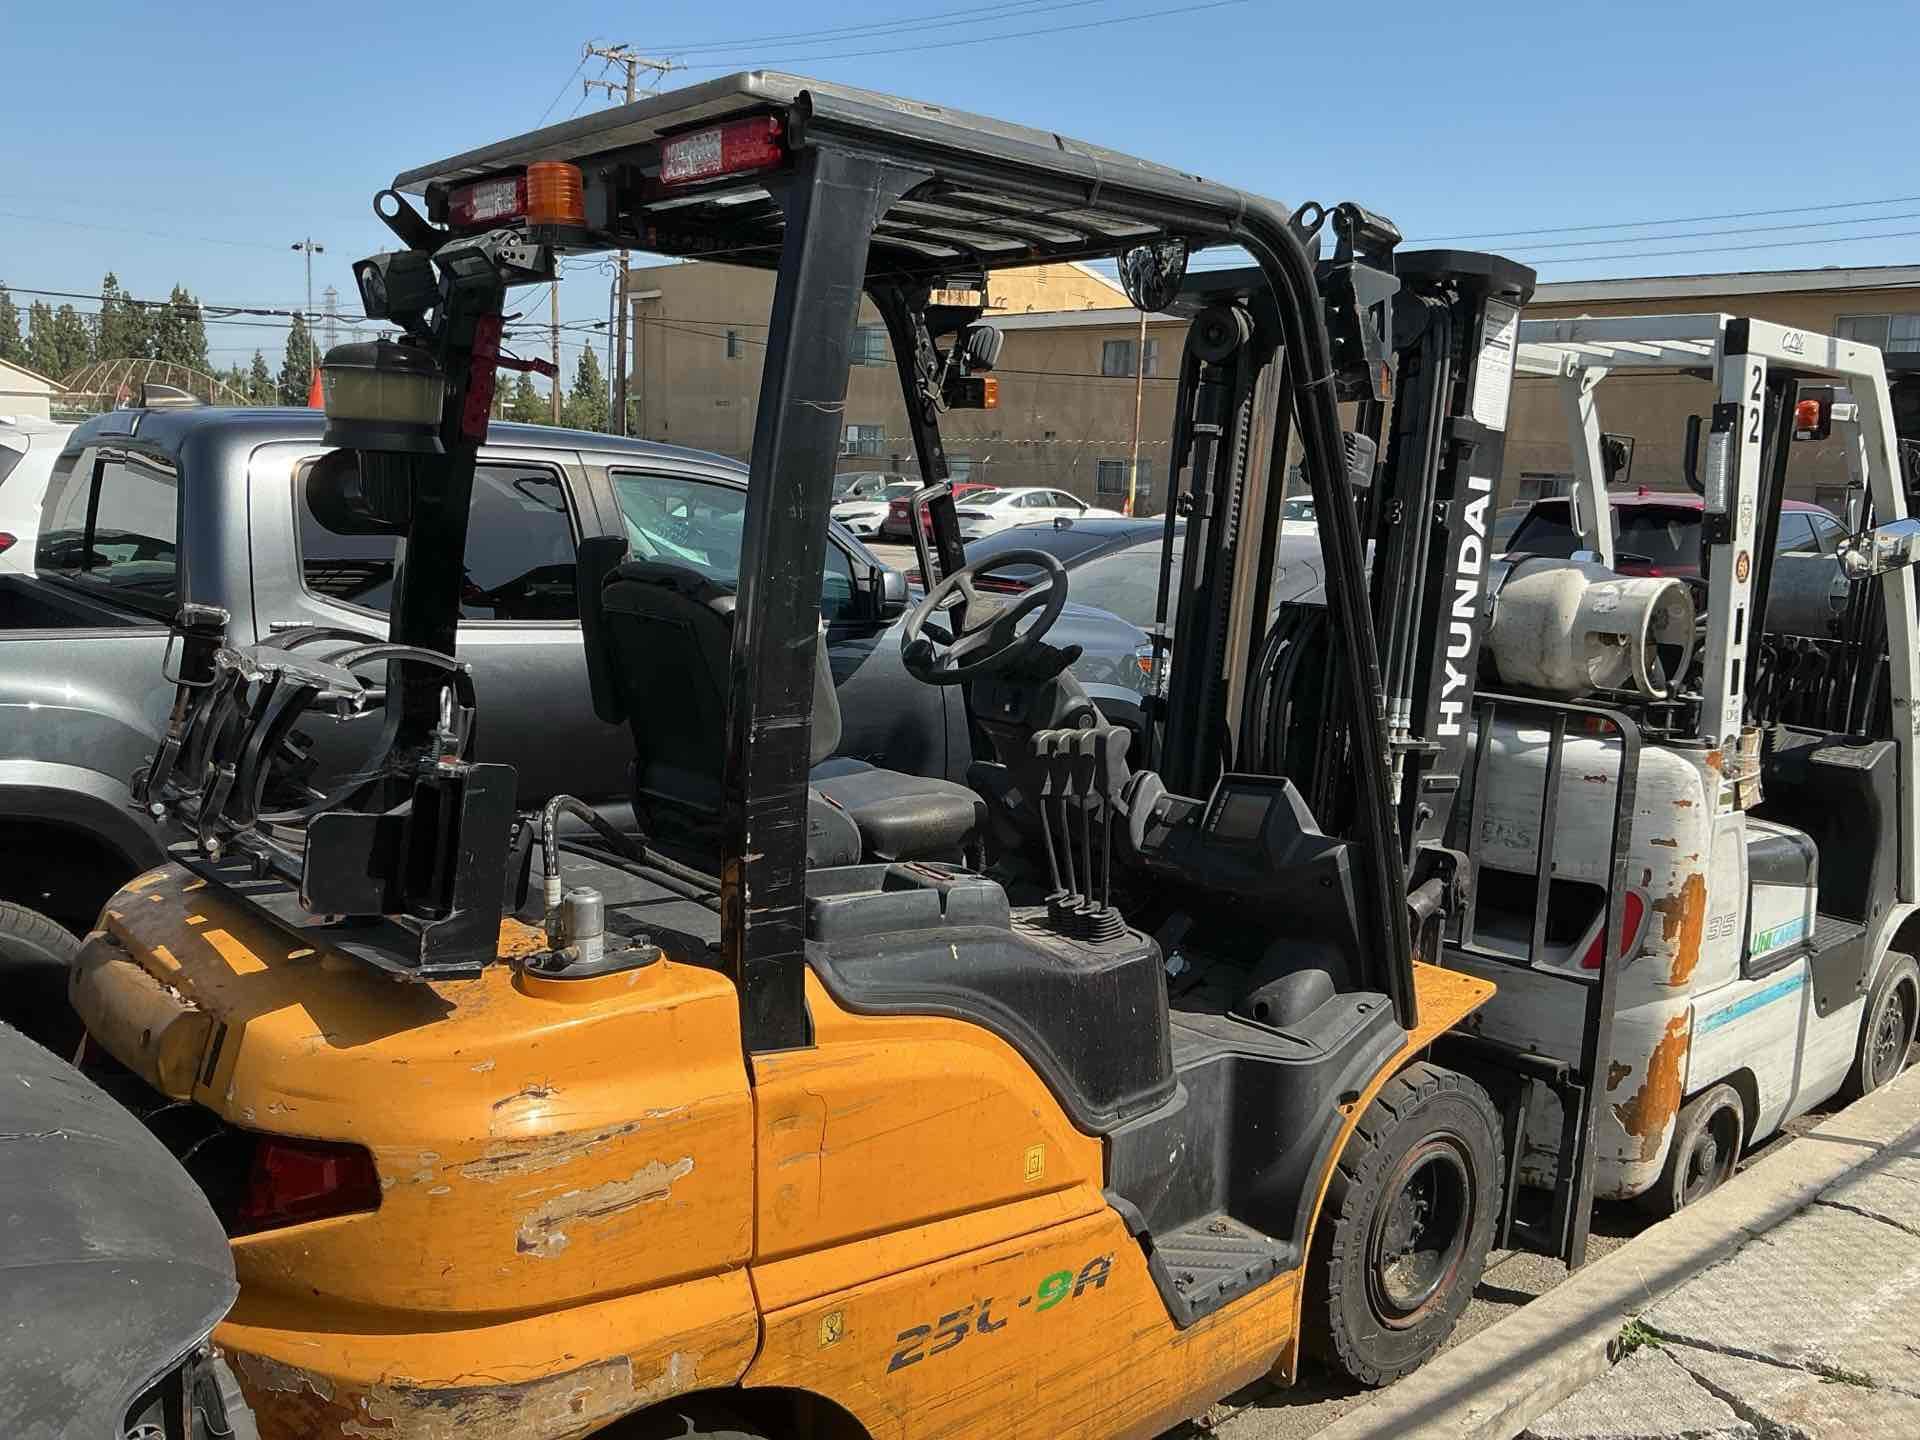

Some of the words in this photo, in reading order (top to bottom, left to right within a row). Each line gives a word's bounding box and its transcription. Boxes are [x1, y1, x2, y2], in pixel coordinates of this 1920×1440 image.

[1748, 365, 1763, 444] 22
[1437, 476, 1493, 737] HYUNDAI
[1706, 911, 1738, 942] 35
